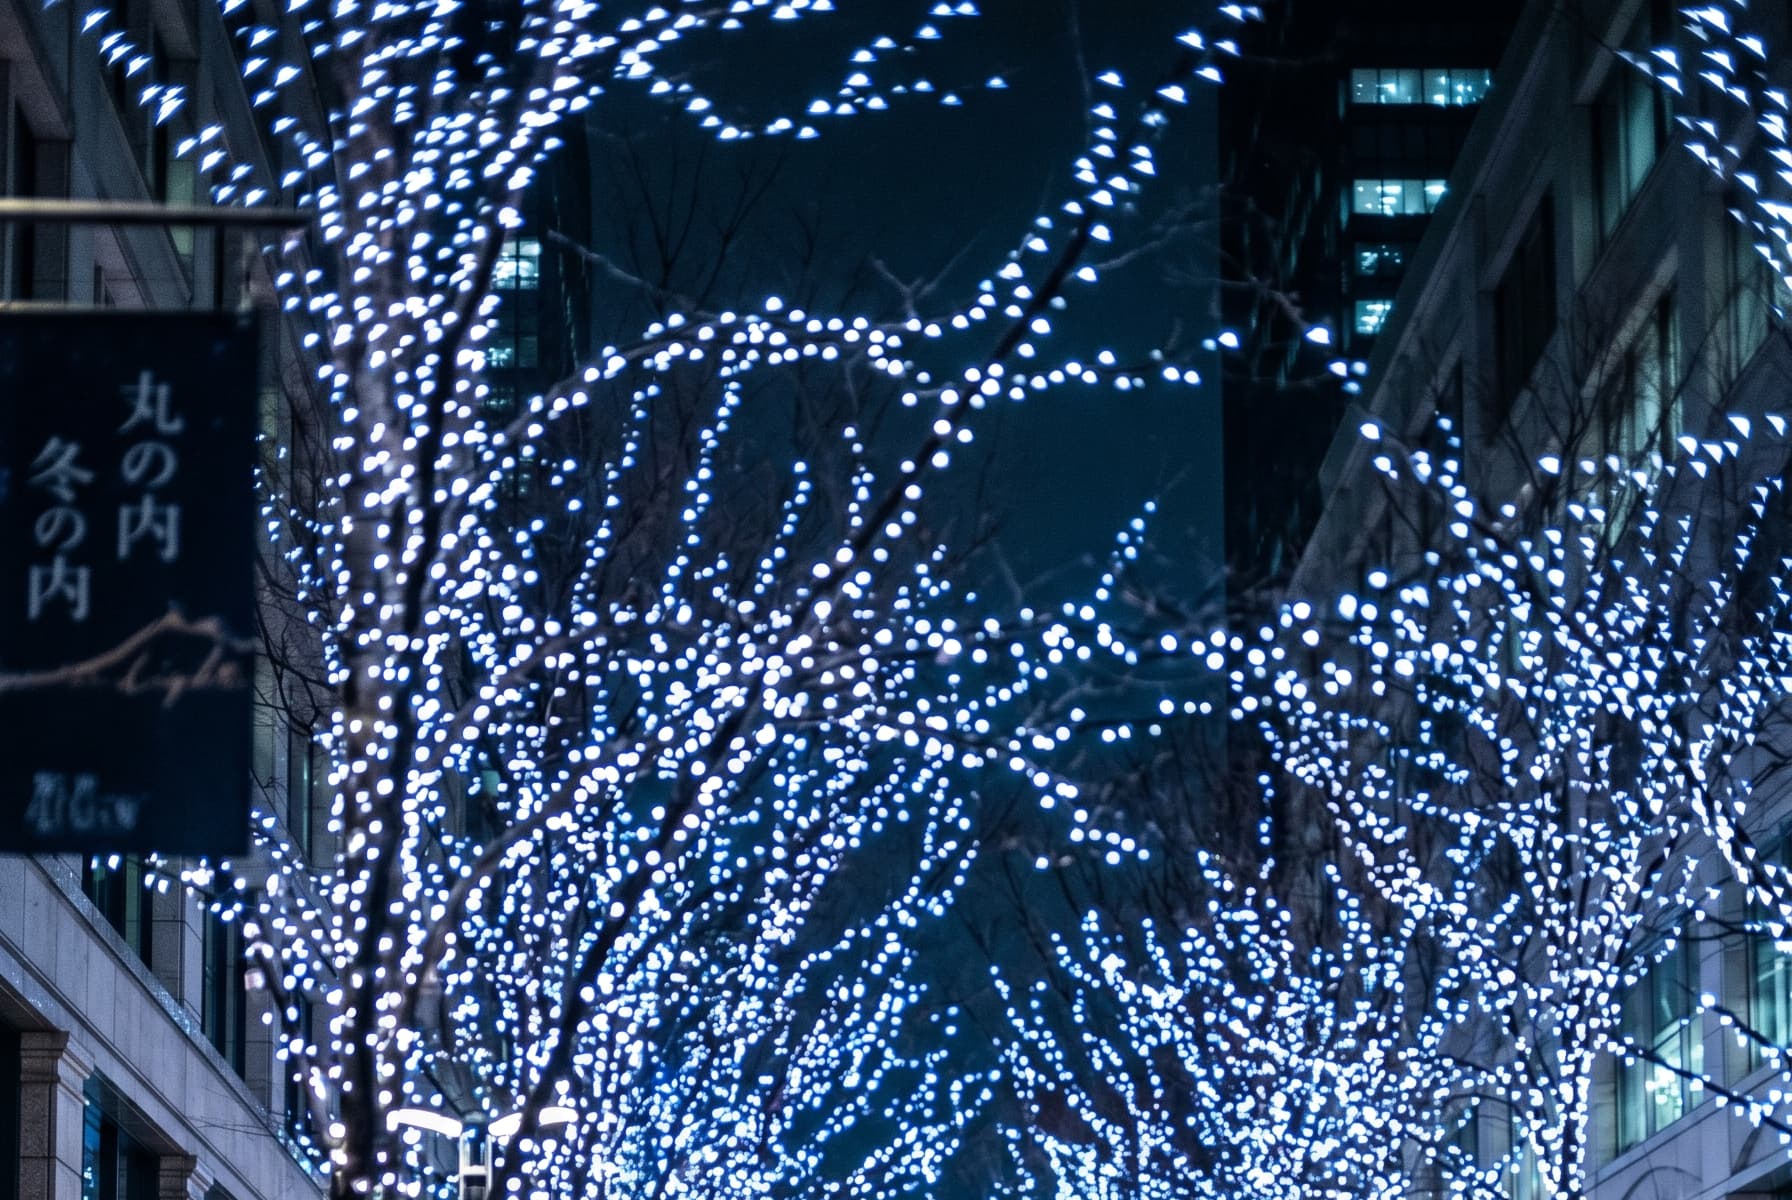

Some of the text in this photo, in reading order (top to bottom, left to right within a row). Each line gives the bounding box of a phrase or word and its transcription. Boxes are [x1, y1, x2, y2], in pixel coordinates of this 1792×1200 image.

[27, 435, 96, 621] 冬の内
[116, 369, 186, 562] 丸の内
